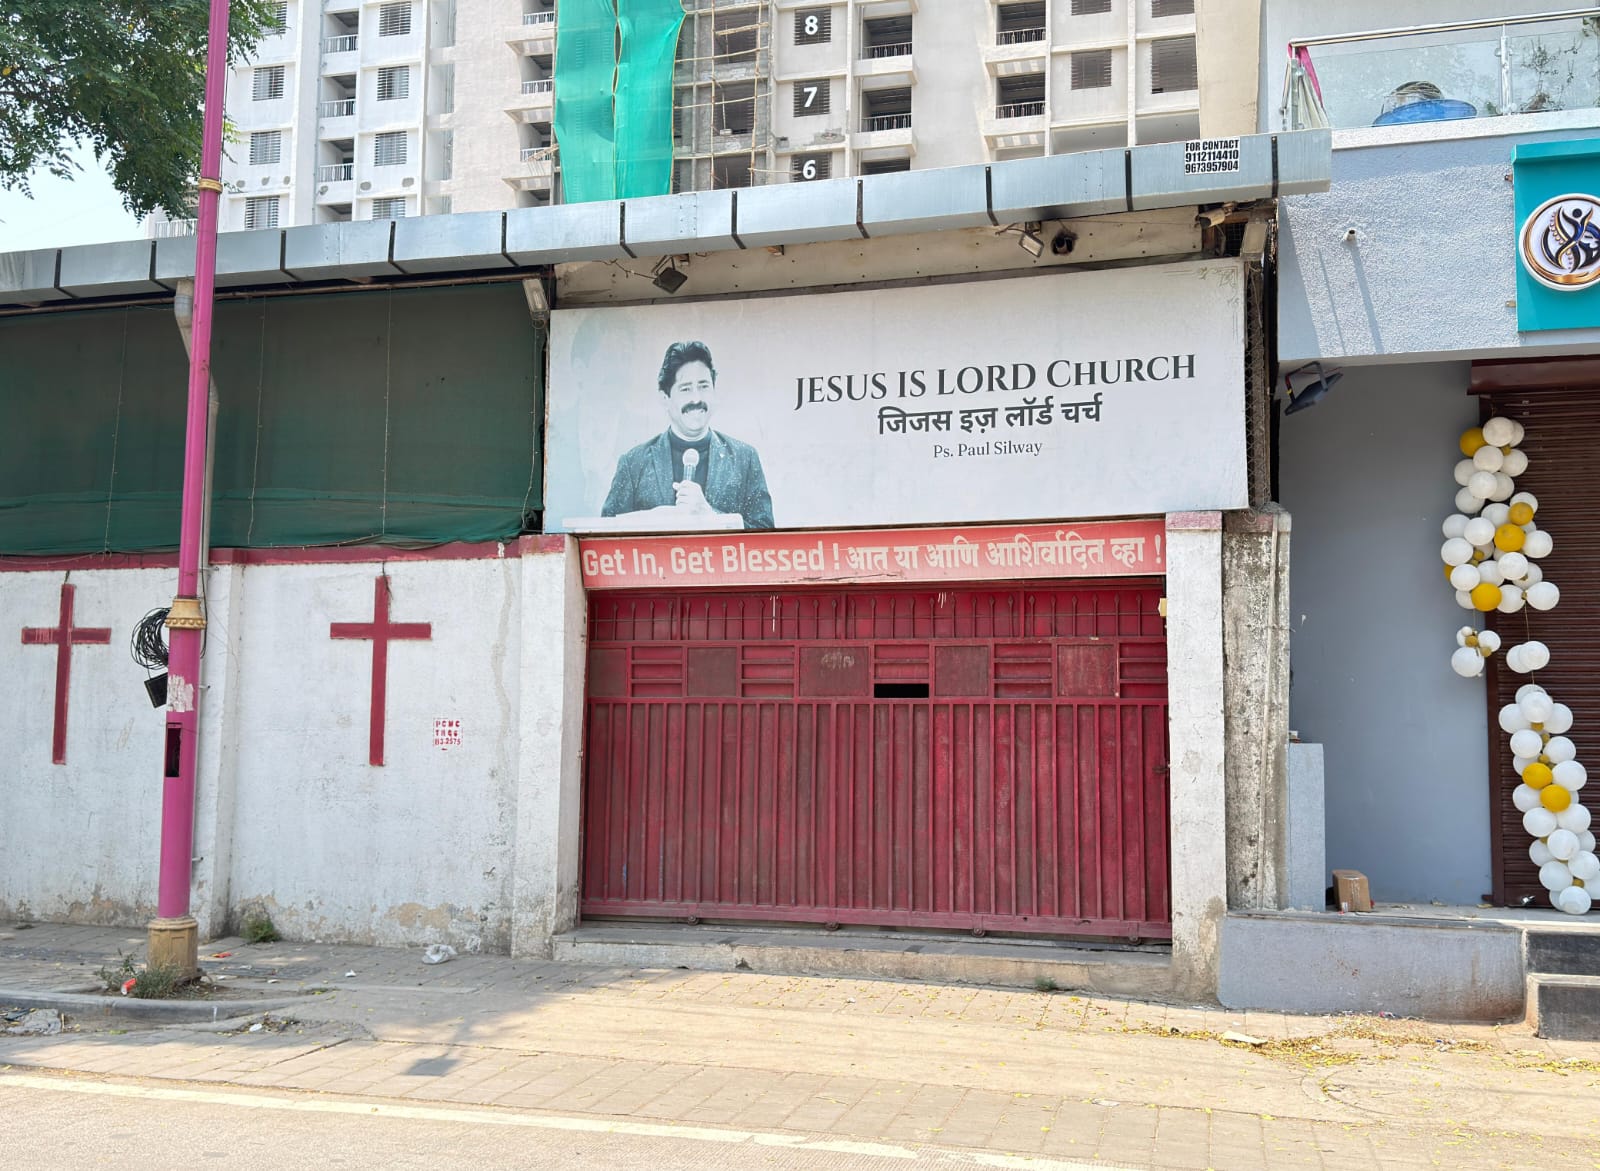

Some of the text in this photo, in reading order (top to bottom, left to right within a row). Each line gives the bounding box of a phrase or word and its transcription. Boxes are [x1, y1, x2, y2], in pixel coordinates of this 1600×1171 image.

[804, 15, 819, 35] 8
[803, 86, 818, 108] 7
[1185, 139, 1239, 151] FOR CONTACT
[1185, 150, 1239, 162] 9112114410
[802, 159, 816, 180] 6
[1185, 160, 1239, 173] 9673957904
[794, 354, 1195, 411] JESUS IS LORD CHURCH
[878, 392, 1103, 435] जिजस इज़ लॉर्ड चर्च
[933, 440, 1042, 458] Ps. Paul Silway
[583, 549, 625, 576] Get
[632, 548, 664, 578] In,
[670, 547, 714, 574] Get
[722, 541, 825, 572] Blessed
[845, 545, 889, 570] आत
[893, 545, 919, 569] या
[924, 535, 979, 569] आणि
[1109, 537, 1145, 569] व्हा
